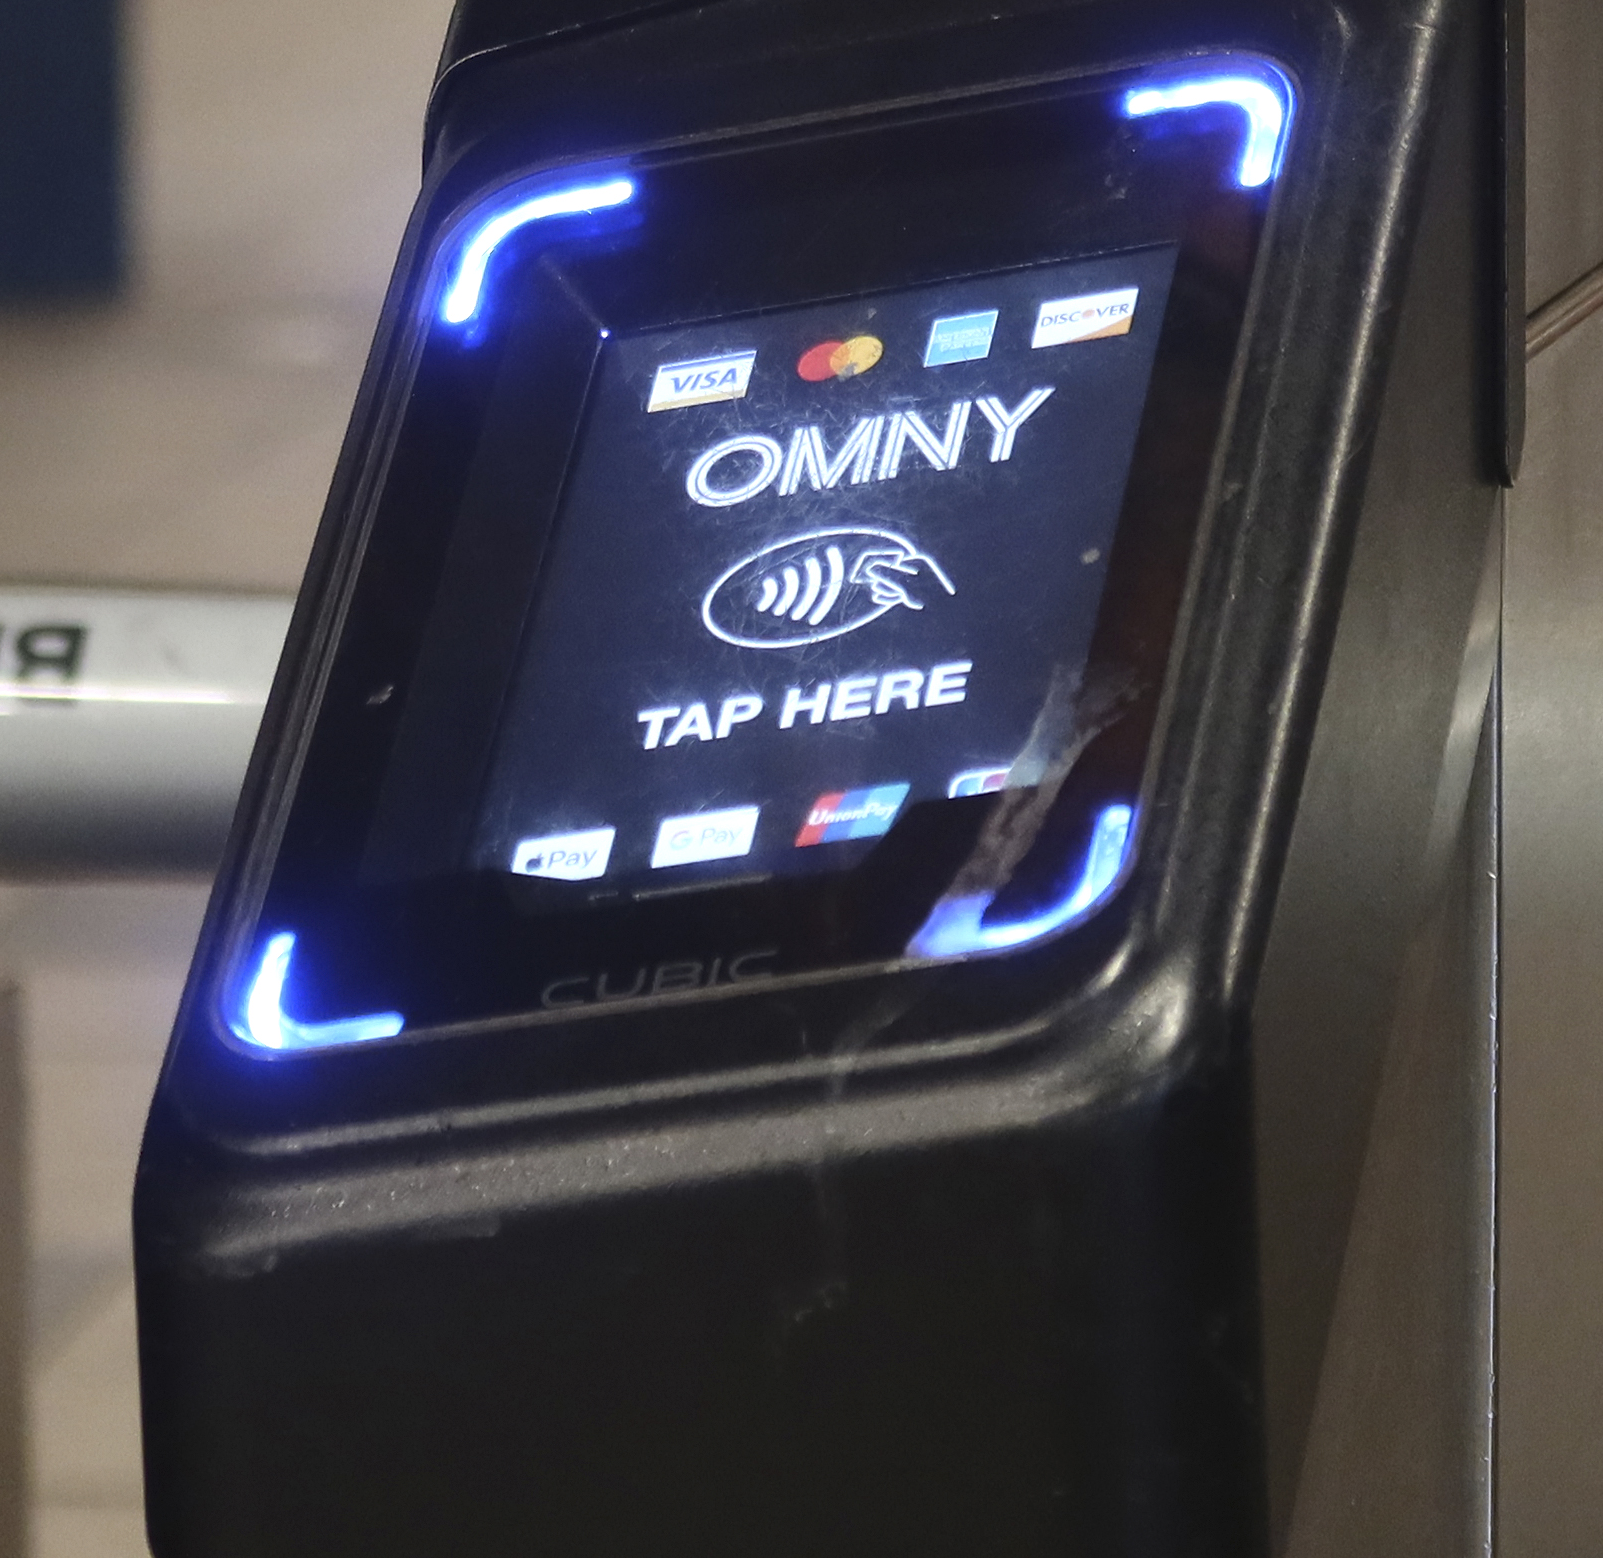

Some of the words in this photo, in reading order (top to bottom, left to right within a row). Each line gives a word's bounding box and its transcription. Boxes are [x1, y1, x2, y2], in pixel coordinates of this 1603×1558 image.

[1041, 303, 1129, 328] DISCOVER
[671, 368, 737, 393] VISA
[686, 388, 1056, 507] OMNY
[637, 696, 764, 750] TAP
[779, 661, 973, 729] HERE
[808, 801, 898, 826] UnionPay
[701, 827, 744, 847] Pay
[547, 850, 598, 869] Pay
[541, 949, 779, 1010] CUBIC
